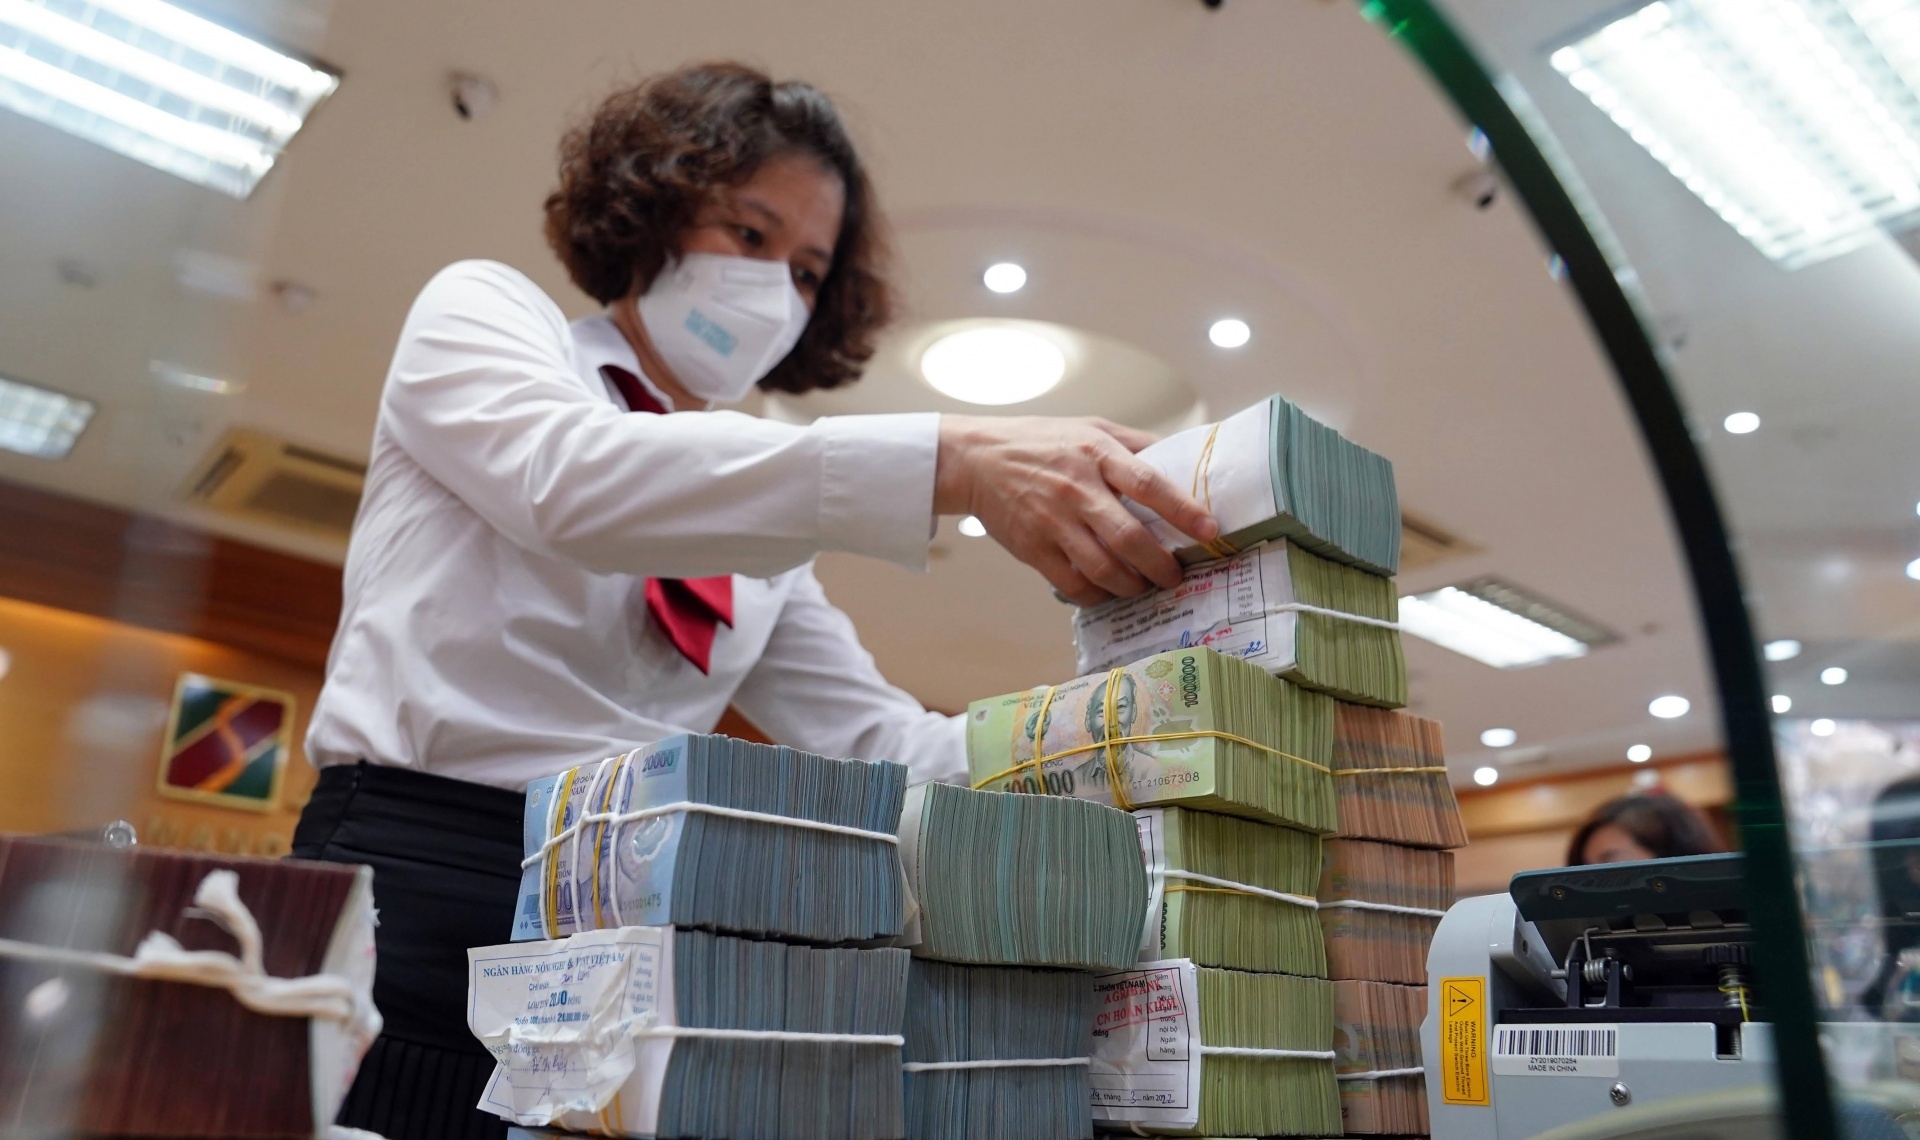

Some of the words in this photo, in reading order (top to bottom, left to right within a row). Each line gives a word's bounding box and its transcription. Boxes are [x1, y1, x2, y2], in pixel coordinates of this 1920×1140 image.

[1182, 656, 1198, 708] 100000
[642, 750, 675, 772] 20000
[1132, 781, 1142, 789] CT
[1147, 772, 1200, 788] 21067308
[484, 965, 509, 977] NGÂN
[511, 962, 534, 975] HÀNG
[1128, 979, 1146, 988] NAM
[1104, 979, 1161, 1005] AGRIBANK
[1097, 1013, 1111, 1026] CN
[1092, 1028, 1109, 1038] đồng
[1160, 1046, 1176, 1055] hàng
[1104, 1094, 1121, 1102] tháng
[1130, 1091, 1137, 1104] 3
